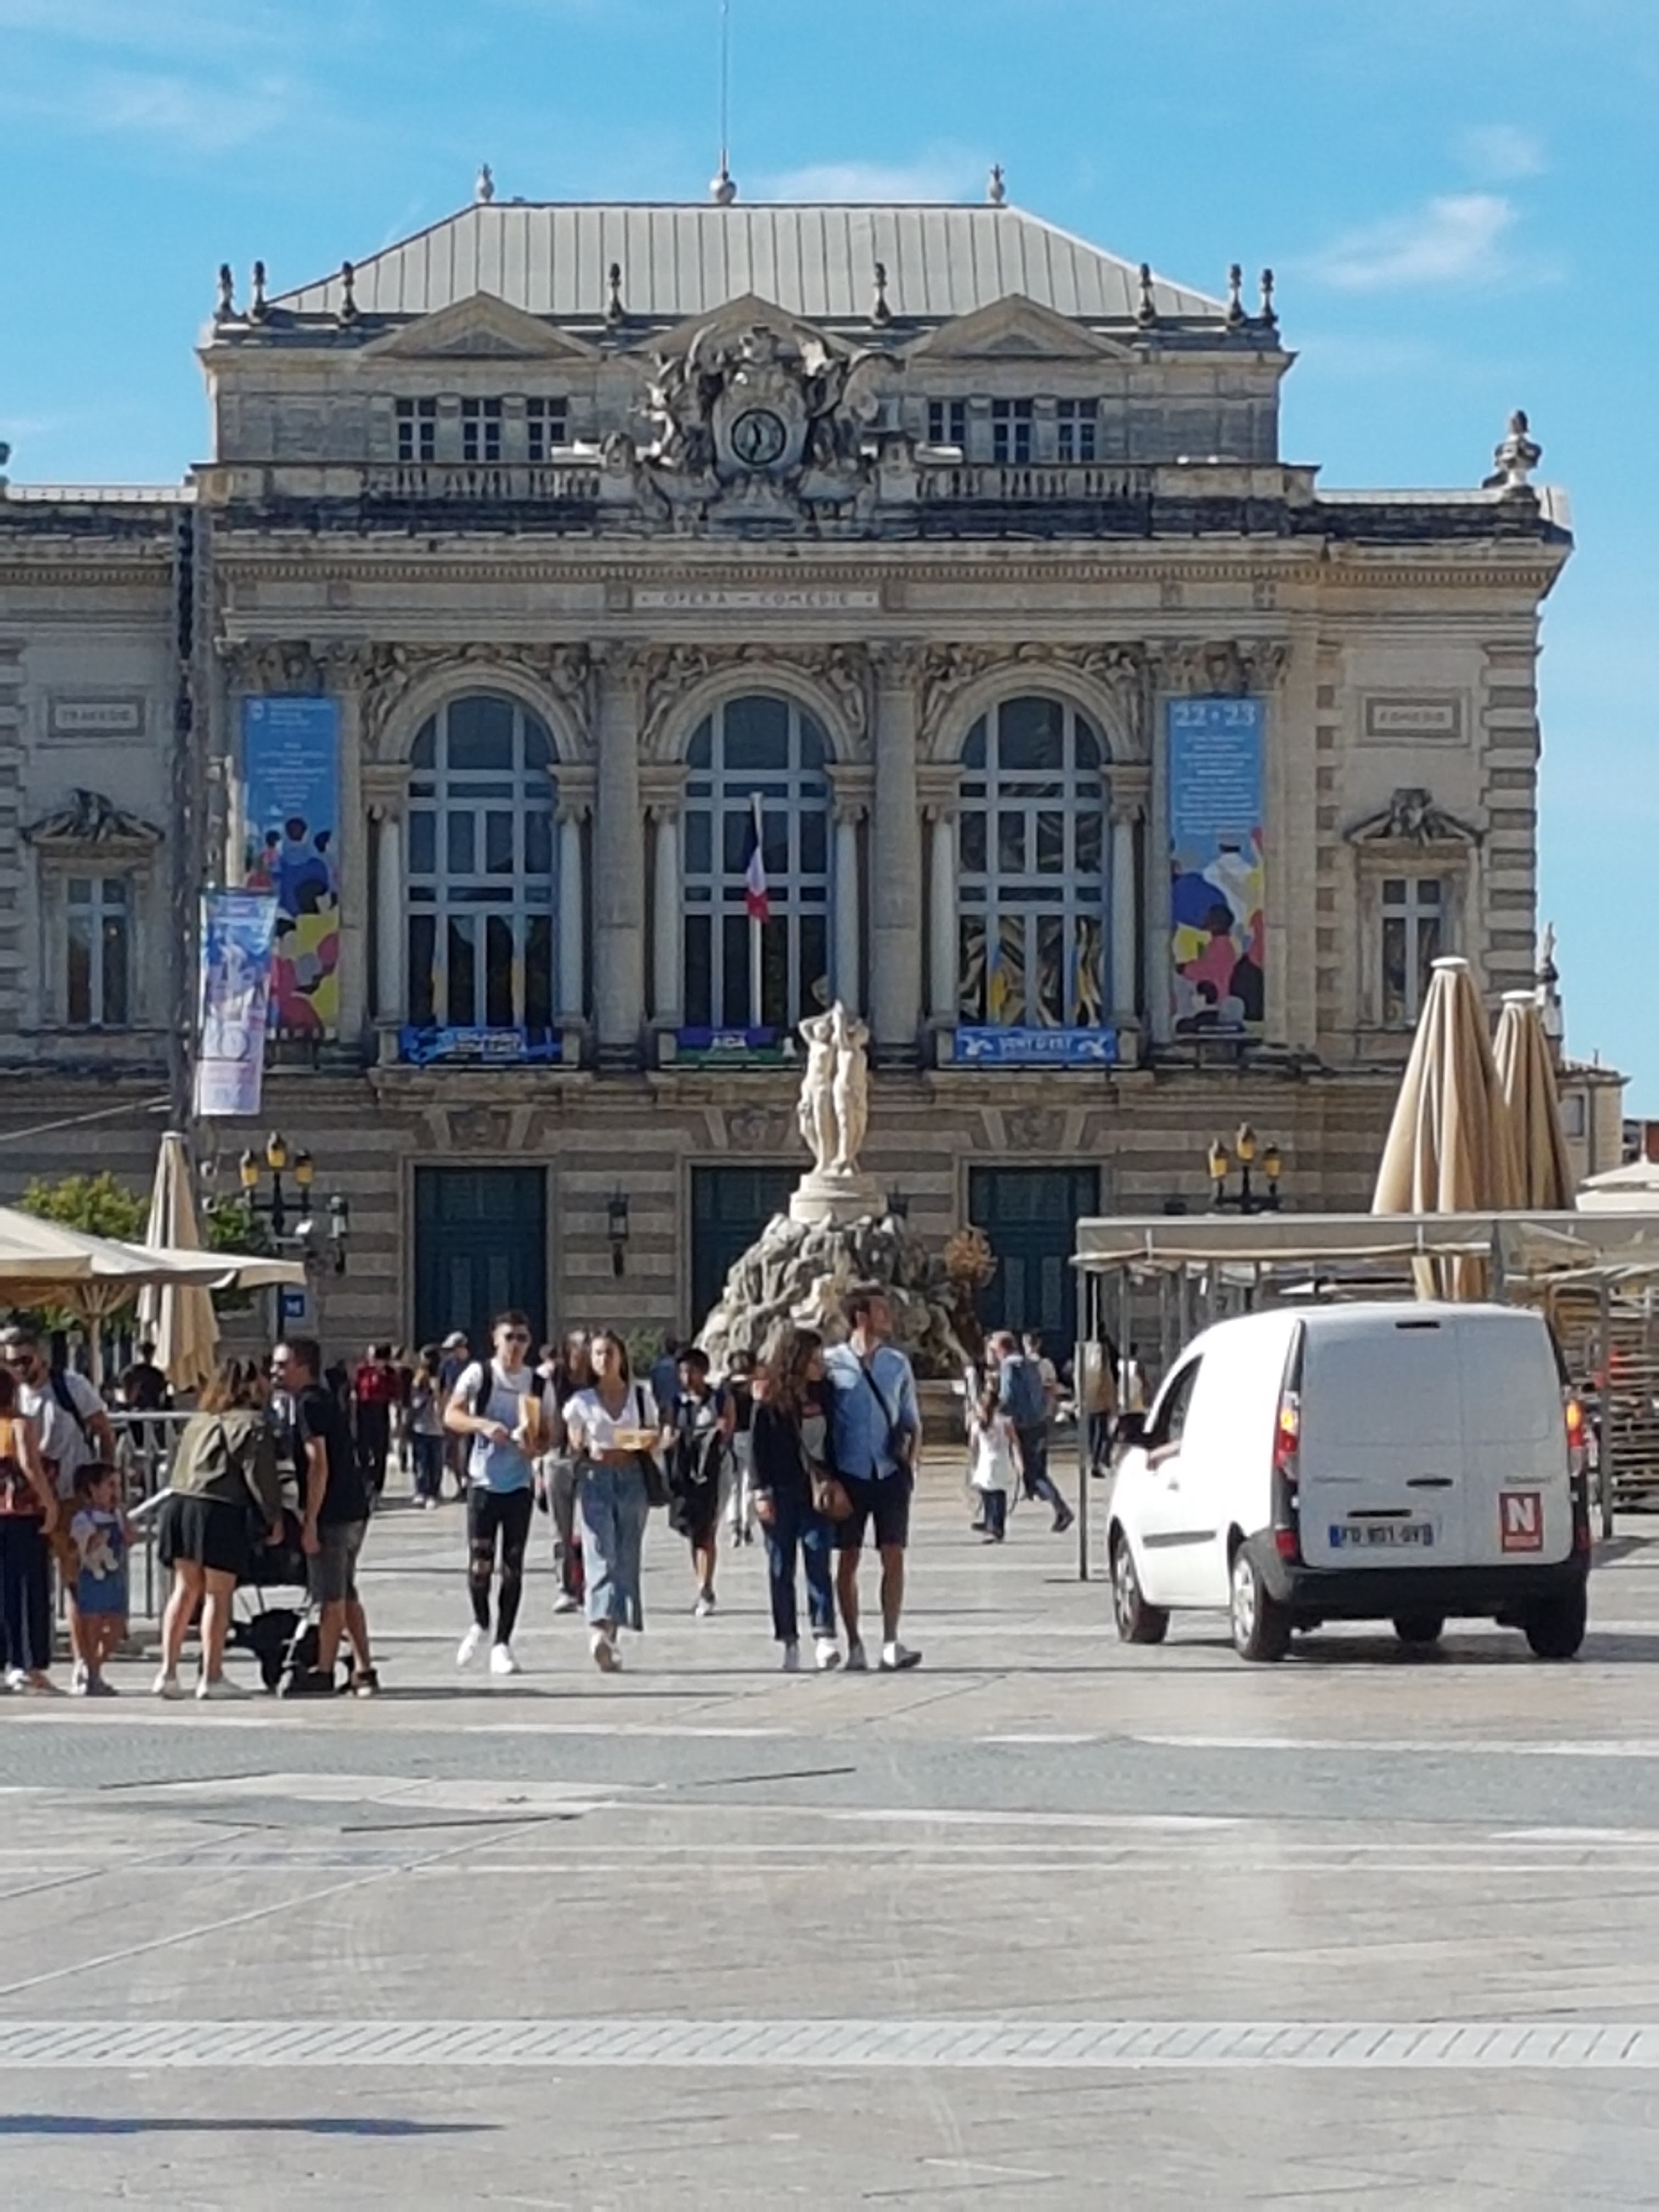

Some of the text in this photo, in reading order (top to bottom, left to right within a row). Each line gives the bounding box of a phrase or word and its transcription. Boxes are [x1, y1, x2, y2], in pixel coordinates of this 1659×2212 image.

[663, 592, 727, 606] OPERA
[759, 592, 848, 606] COMEDIE
[1175, 702, 1255, 726] 22 23
[1506, 1498, 1535, 1532] N
